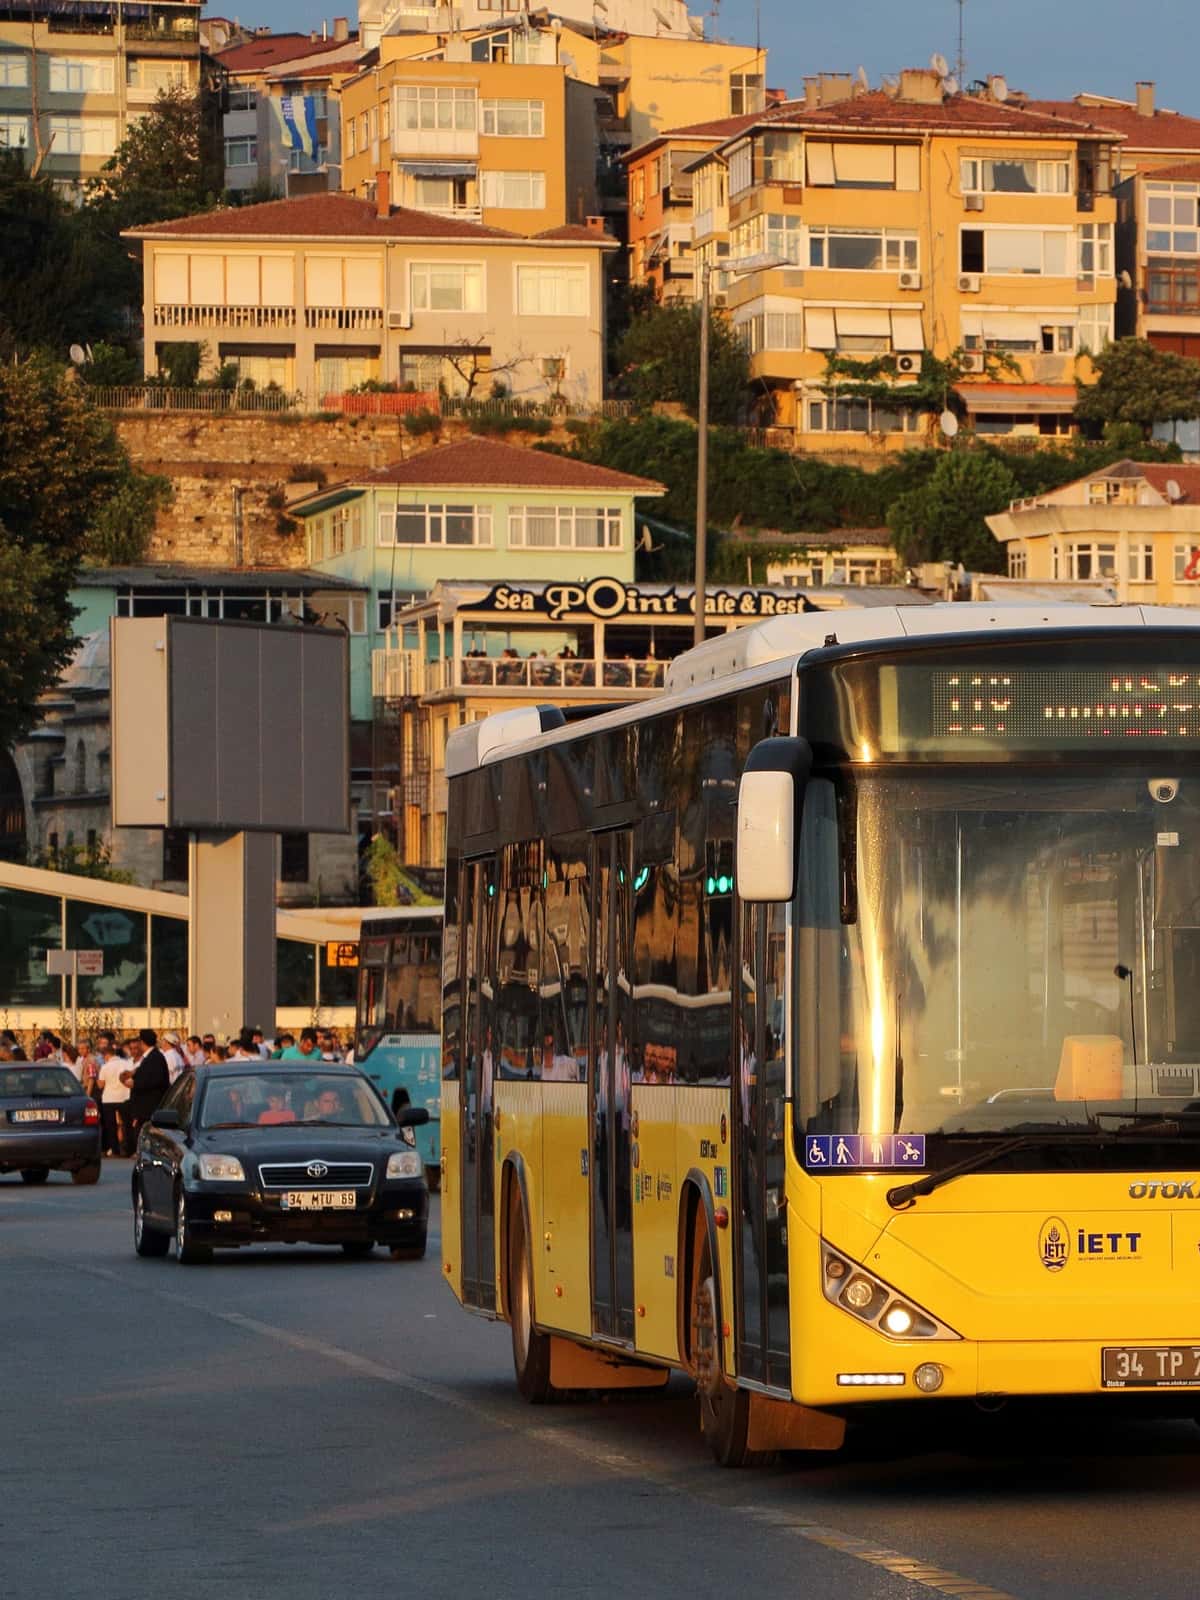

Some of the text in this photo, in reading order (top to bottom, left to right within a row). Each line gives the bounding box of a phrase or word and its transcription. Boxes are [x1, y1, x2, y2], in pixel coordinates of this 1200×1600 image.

[494, 587, 535, 611] Sea
[739, 593, 757, 613] &
[760, 594, 805, 614] Rest
[289, 1194, 302, 1205] 34
[312, 1193, 332, 1205] MTU
[1116, 1352, 1144, 1377] 34
[1156, 1351, 1183, 1377] TP
